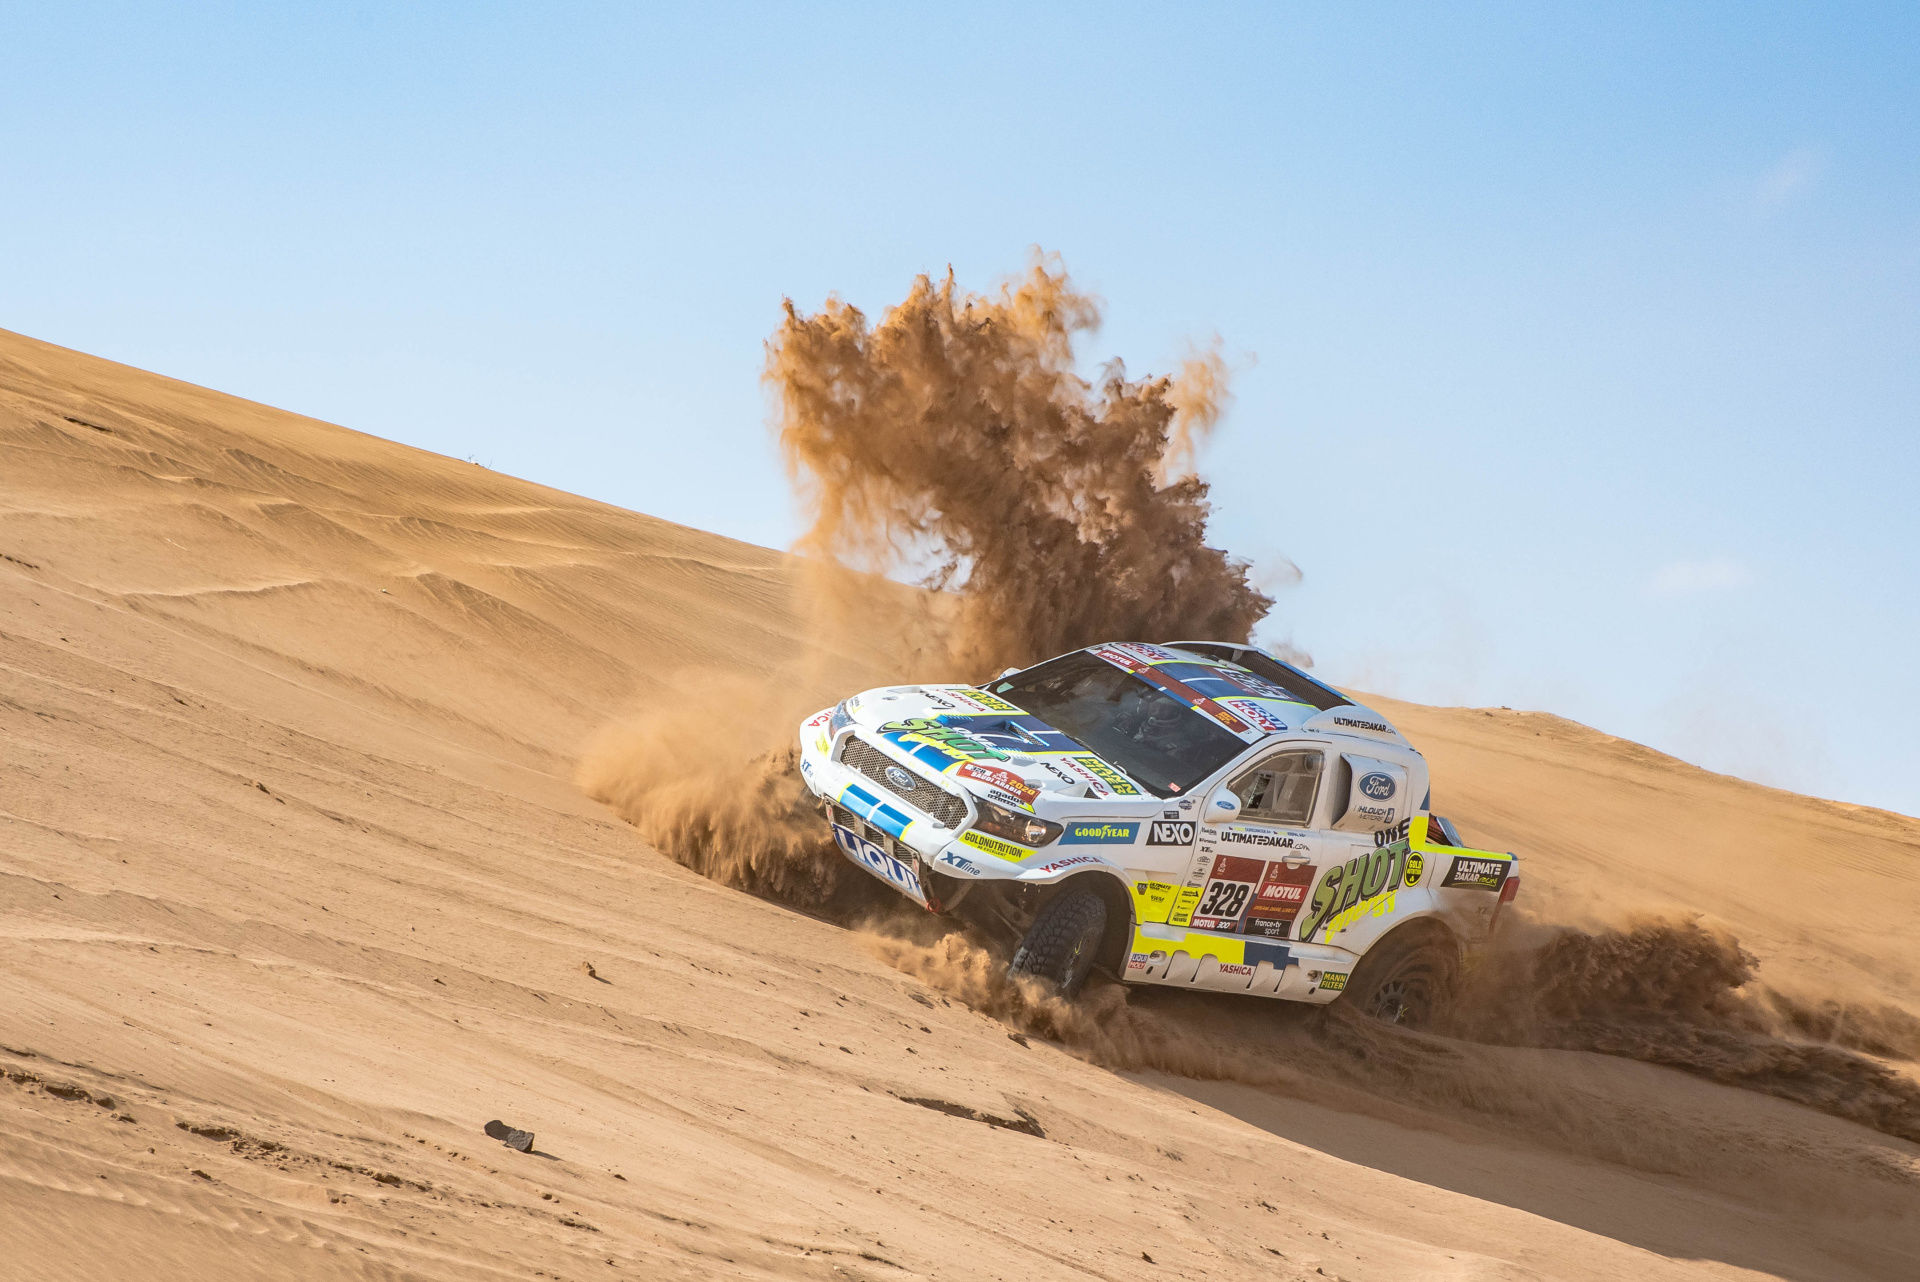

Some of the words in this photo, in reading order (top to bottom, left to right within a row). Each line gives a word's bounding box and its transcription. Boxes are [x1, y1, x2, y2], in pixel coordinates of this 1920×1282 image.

[1101, 652, 1133, 666] MOTUL
[1229, 700, 1277, 731] MOLY
[1241, 699, 1288, 730] LIQUI
[876, 717, 1011, 763] SHOT
[970, 771, 994, 784] SAUDI
[994, 780, 1022, 796] ARABIA
[1008, 779, 1036, 796] 2020
[1039, 762, 1076, 785] NEXO
[1059, 756, 1110, 797] YASHICA
[1075, 757, 1127, 795] FILTER
[1086, 757, 1138, 795] MANN
[1366, 776, 1391, 797] Ford
[1074, 824, 1130, 840] GOODYEAR
[1153, 822, 1194, 845] NEXO
[1374, 816, 1411, 848] ONE
[964, 832, 1024, 859] GOLDNUTRITION
[939, 850, 982, 877] XTline
[1039, 855, 1104, 874] YASHICA
[1457, 860, 1503, 876] ULTIMATE
[1453, 871, 1480, 882] DAKAR
[1199, 881, 1250, 918] 328
[1262, 884, 1303, 900] MOTUL
[1299, 837, 1412, 943] SHOT
[1192, 918, 1217, 929] MOTUL
[1324, 889, 1398, 945] energy
[1264, 927, 1280, 937] sport
[1219, 963, 1252, 976] YASHICA
[1323, 973, 1347, 983] MANN
[1320, 980, 1344, 990] FILTER
